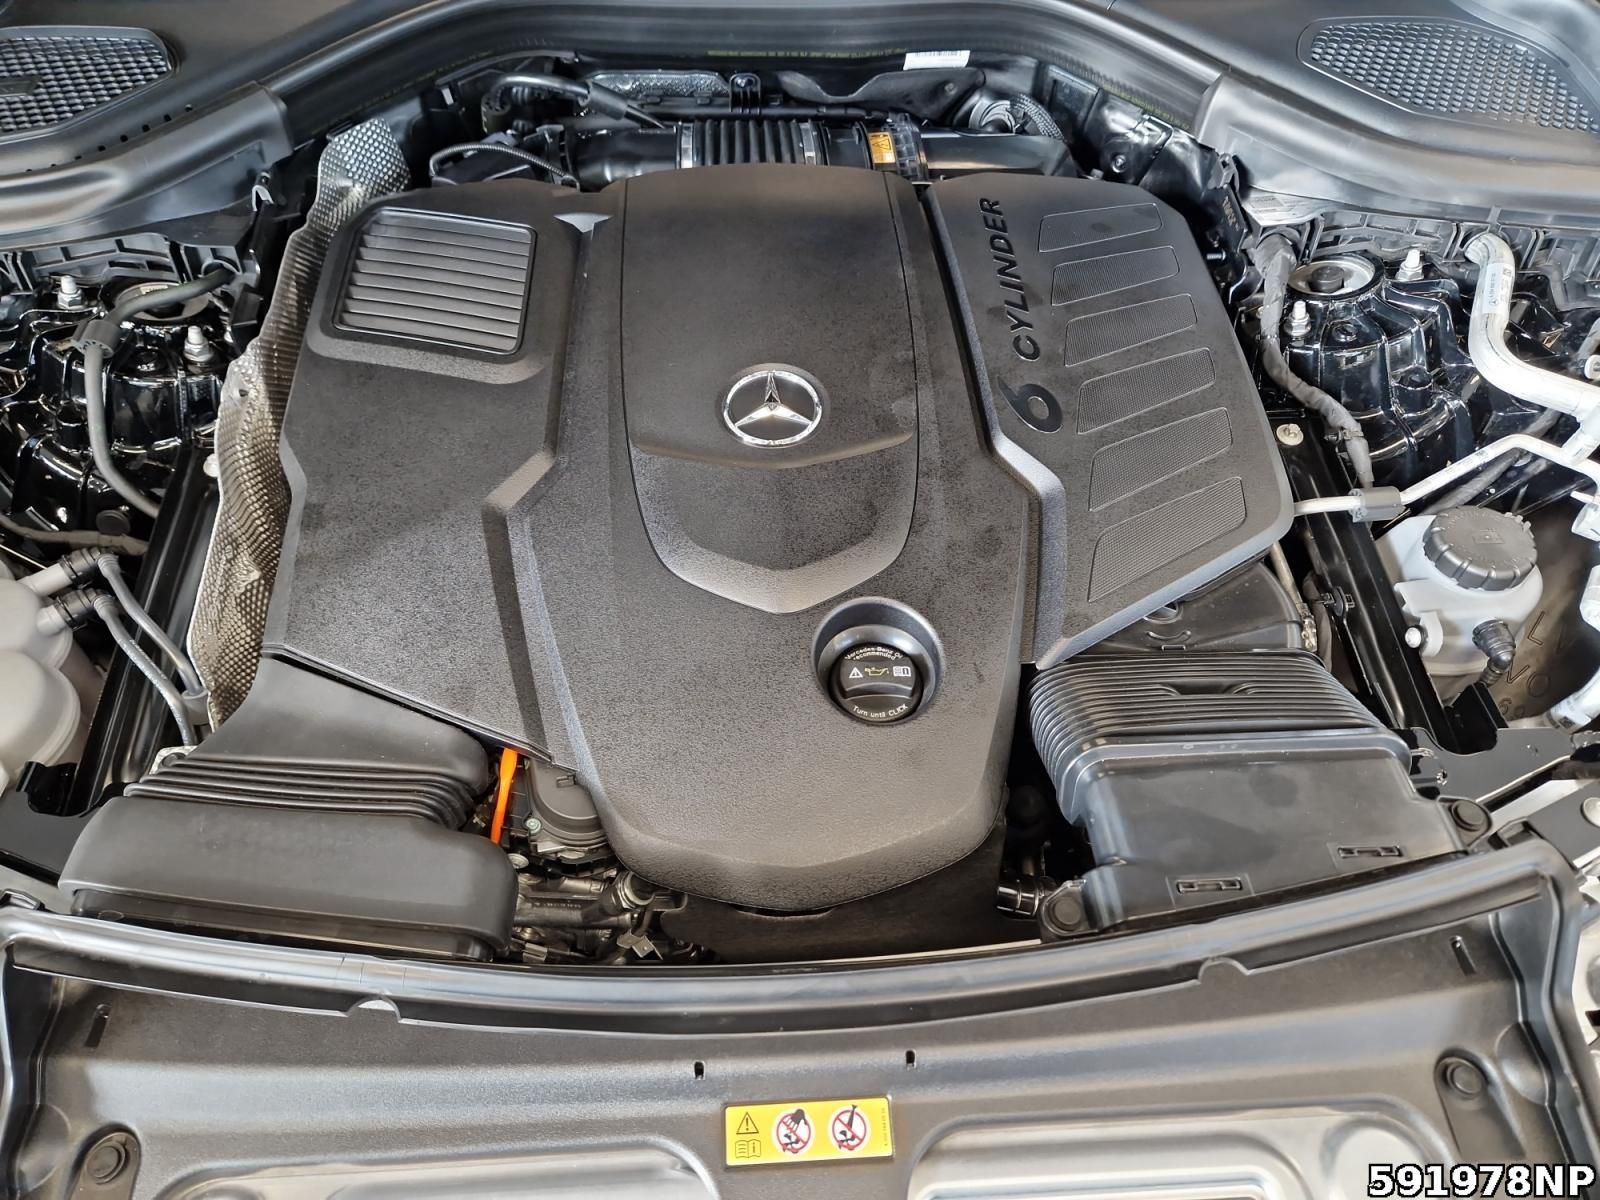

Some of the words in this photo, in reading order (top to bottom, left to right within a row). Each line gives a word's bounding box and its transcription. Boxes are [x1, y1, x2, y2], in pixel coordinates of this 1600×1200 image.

[978, 197, 1041, 362] CYLINDER
[997, 374, 1064, 434] 6
[852, 651, 896, 661] recommended
[853, 704, 868, 717] Turn
[888, 703, 908, 717] CLICK
